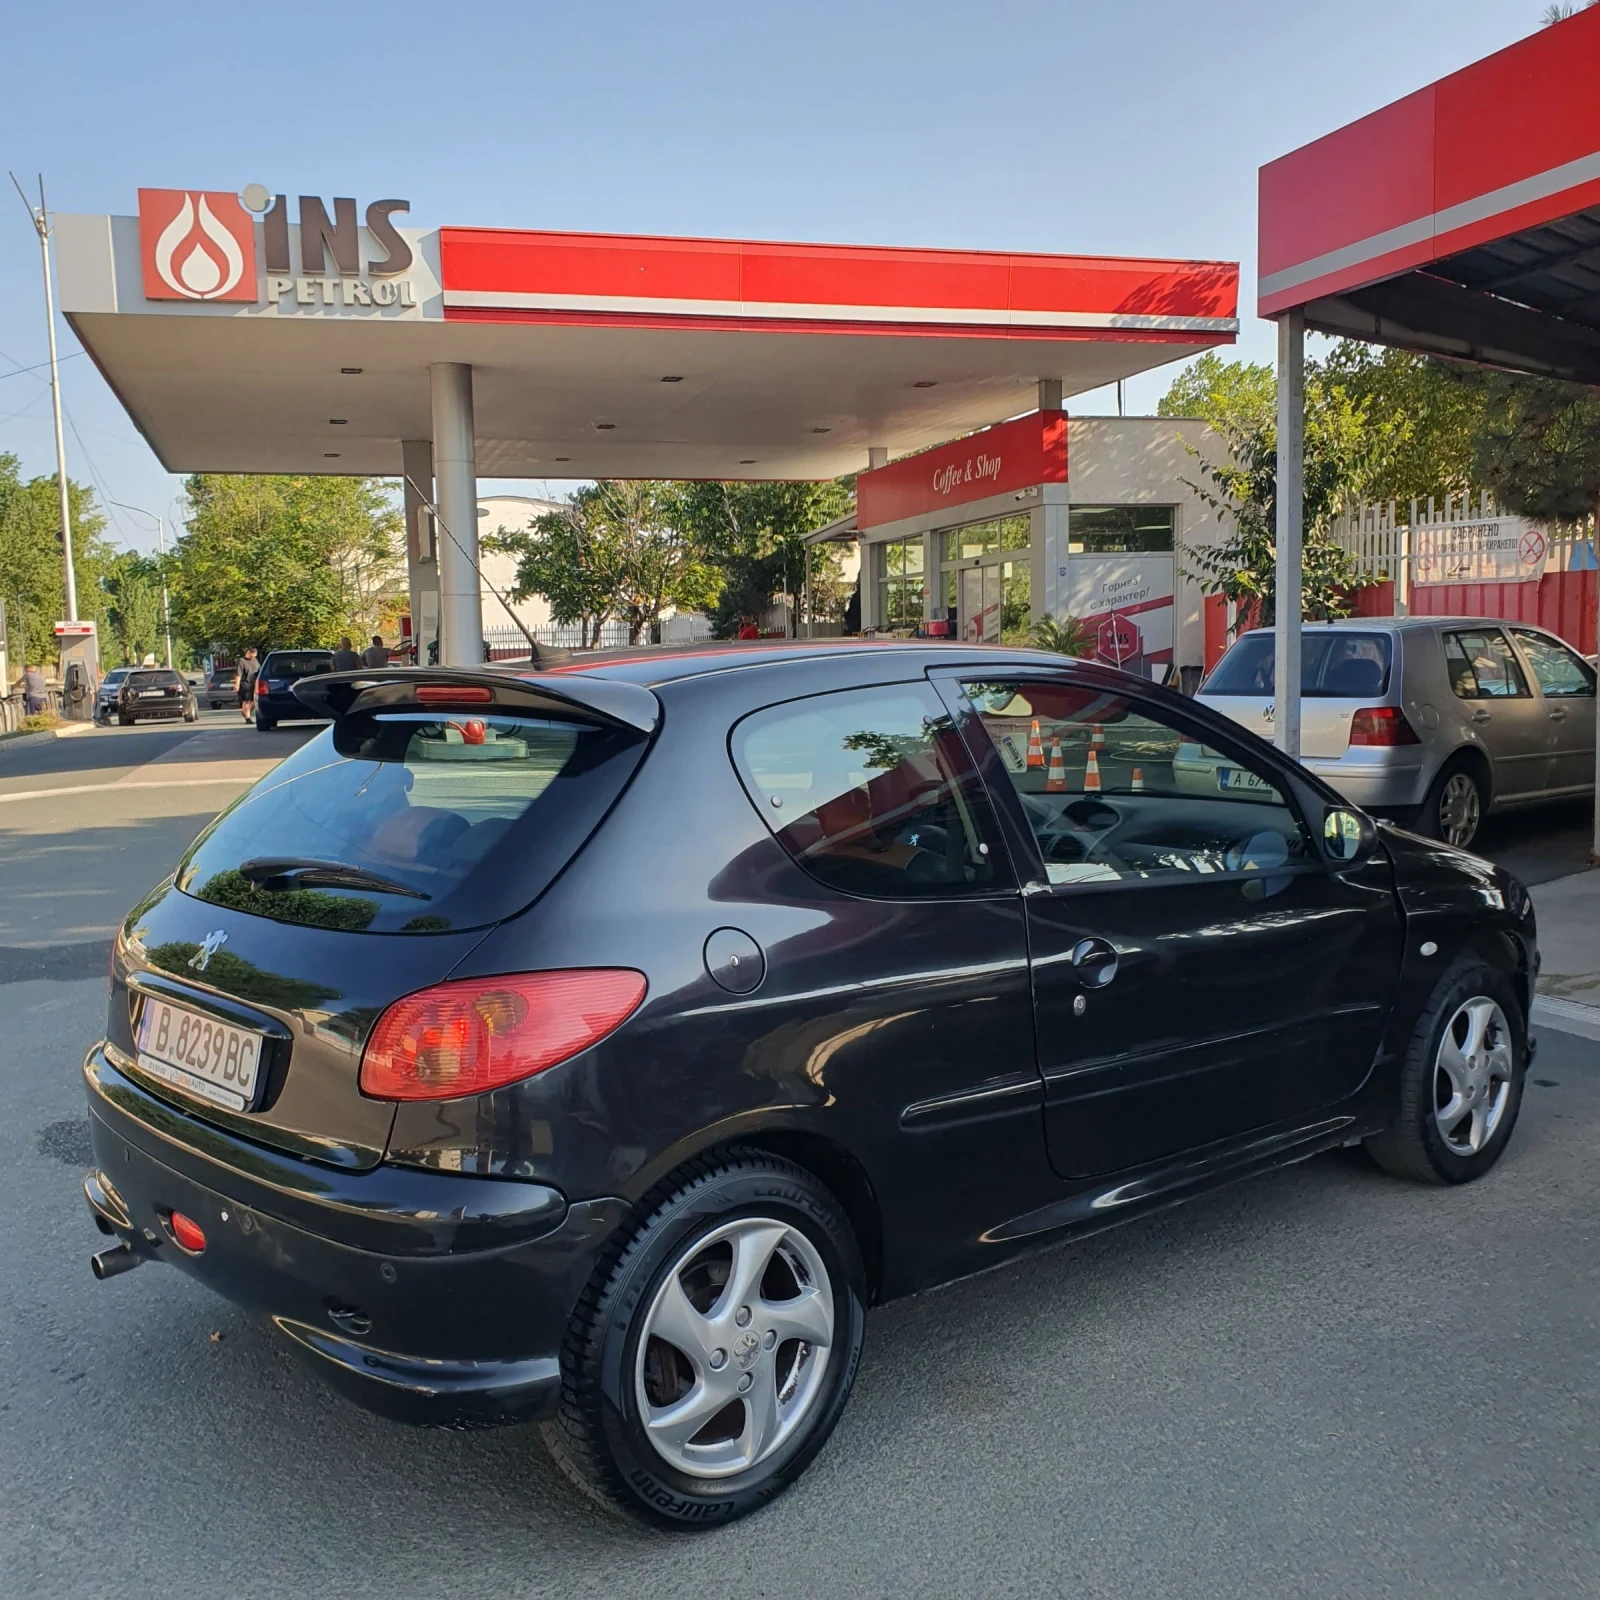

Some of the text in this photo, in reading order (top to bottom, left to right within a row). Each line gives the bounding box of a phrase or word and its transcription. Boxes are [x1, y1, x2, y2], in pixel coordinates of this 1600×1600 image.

[267, 277, 417, 307] PETROL
[933, 454, 1001, 495] Coffee & Shop
[1452, 522, 1499, 540] ЗАБРАНЕНО
[1099, 586, 1150, 608] характер!
[1102, 578, 1139, 594] Горива
[1005, 741, 1024, 769] mobile.bg
